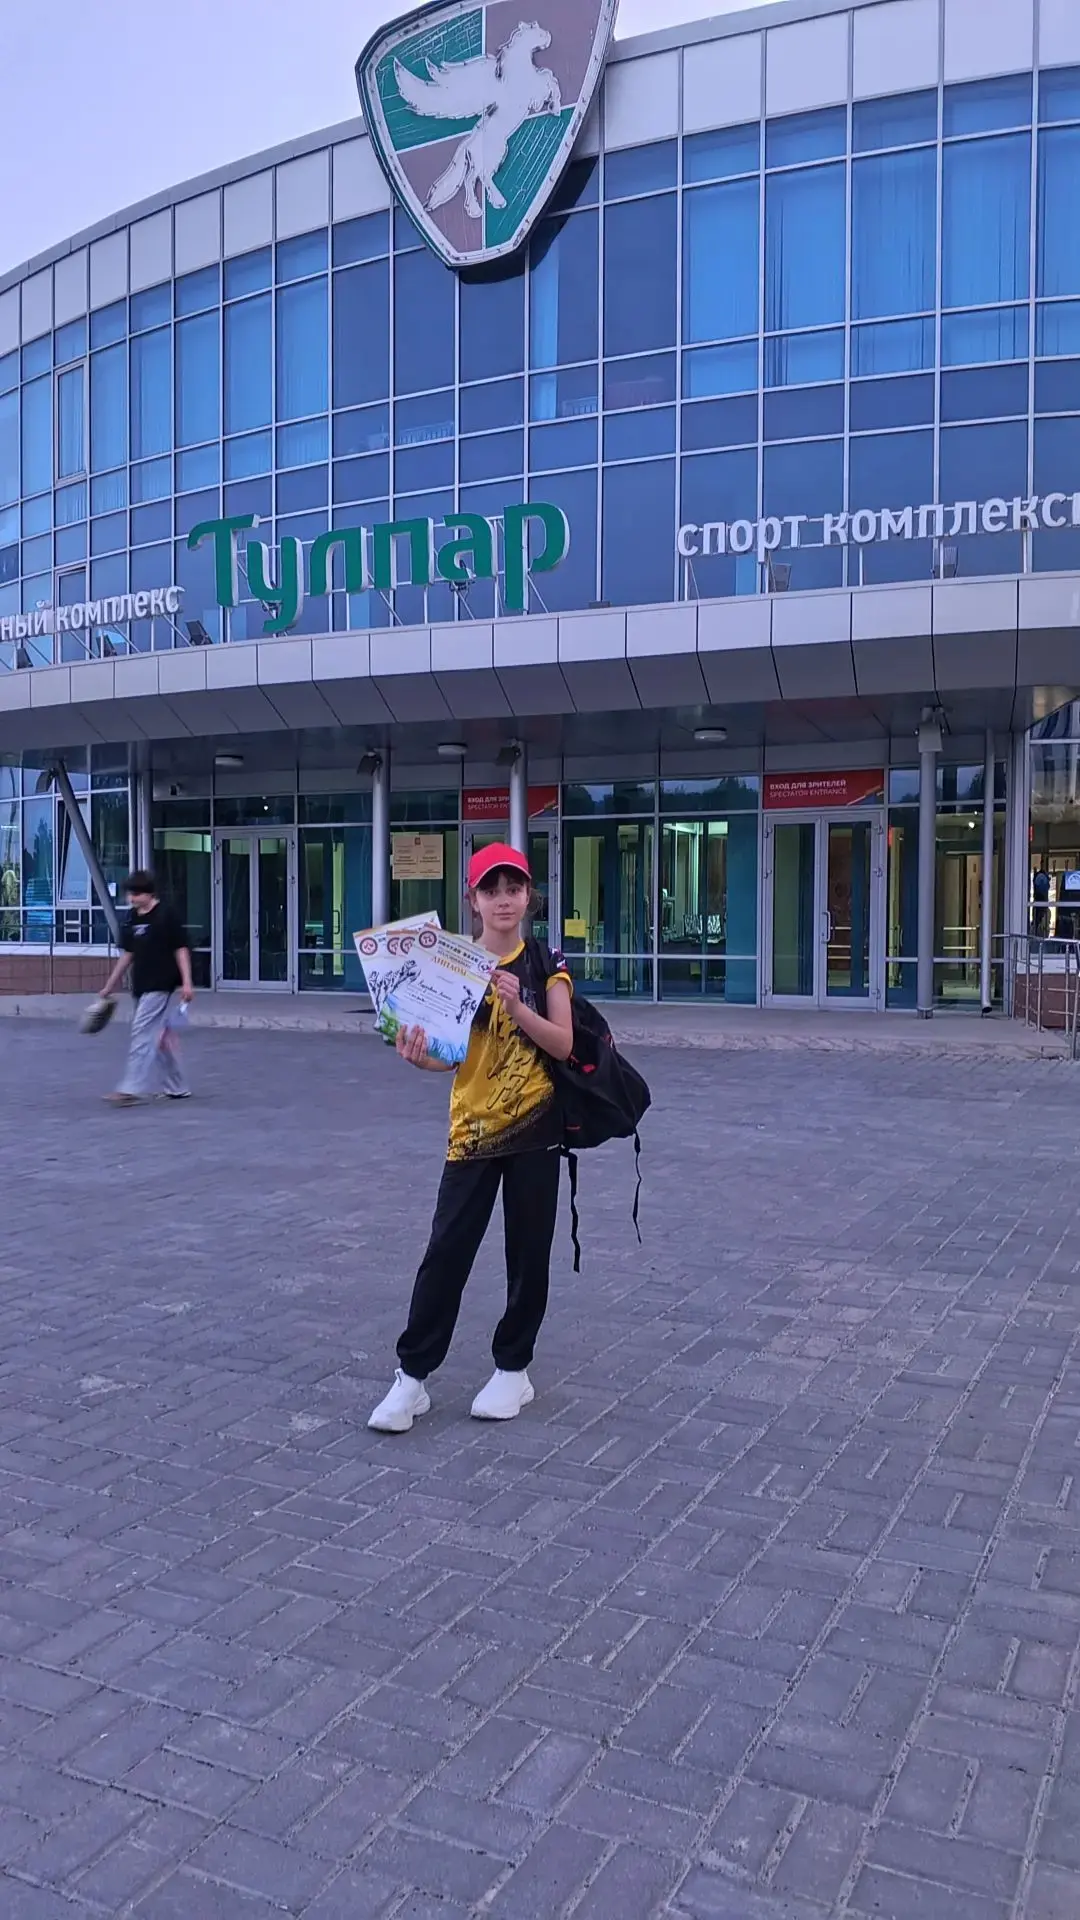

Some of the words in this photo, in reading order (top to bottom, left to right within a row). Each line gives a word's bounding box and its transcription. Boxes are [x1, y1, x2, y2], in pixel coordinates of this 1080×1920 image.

[677, 514, 807, 563] спорт
[823, 491, 1080, 546] комплекс
[187, 501, 571, 633] Тулпар
[57, 586, 185, 632] комплекс
[769, 789, 808, 798] SPECTATOR
[809, 787, 847, 796] ENTRANCE
[808, 779, 847, 788] ЗРИТЕЛЕЙ
